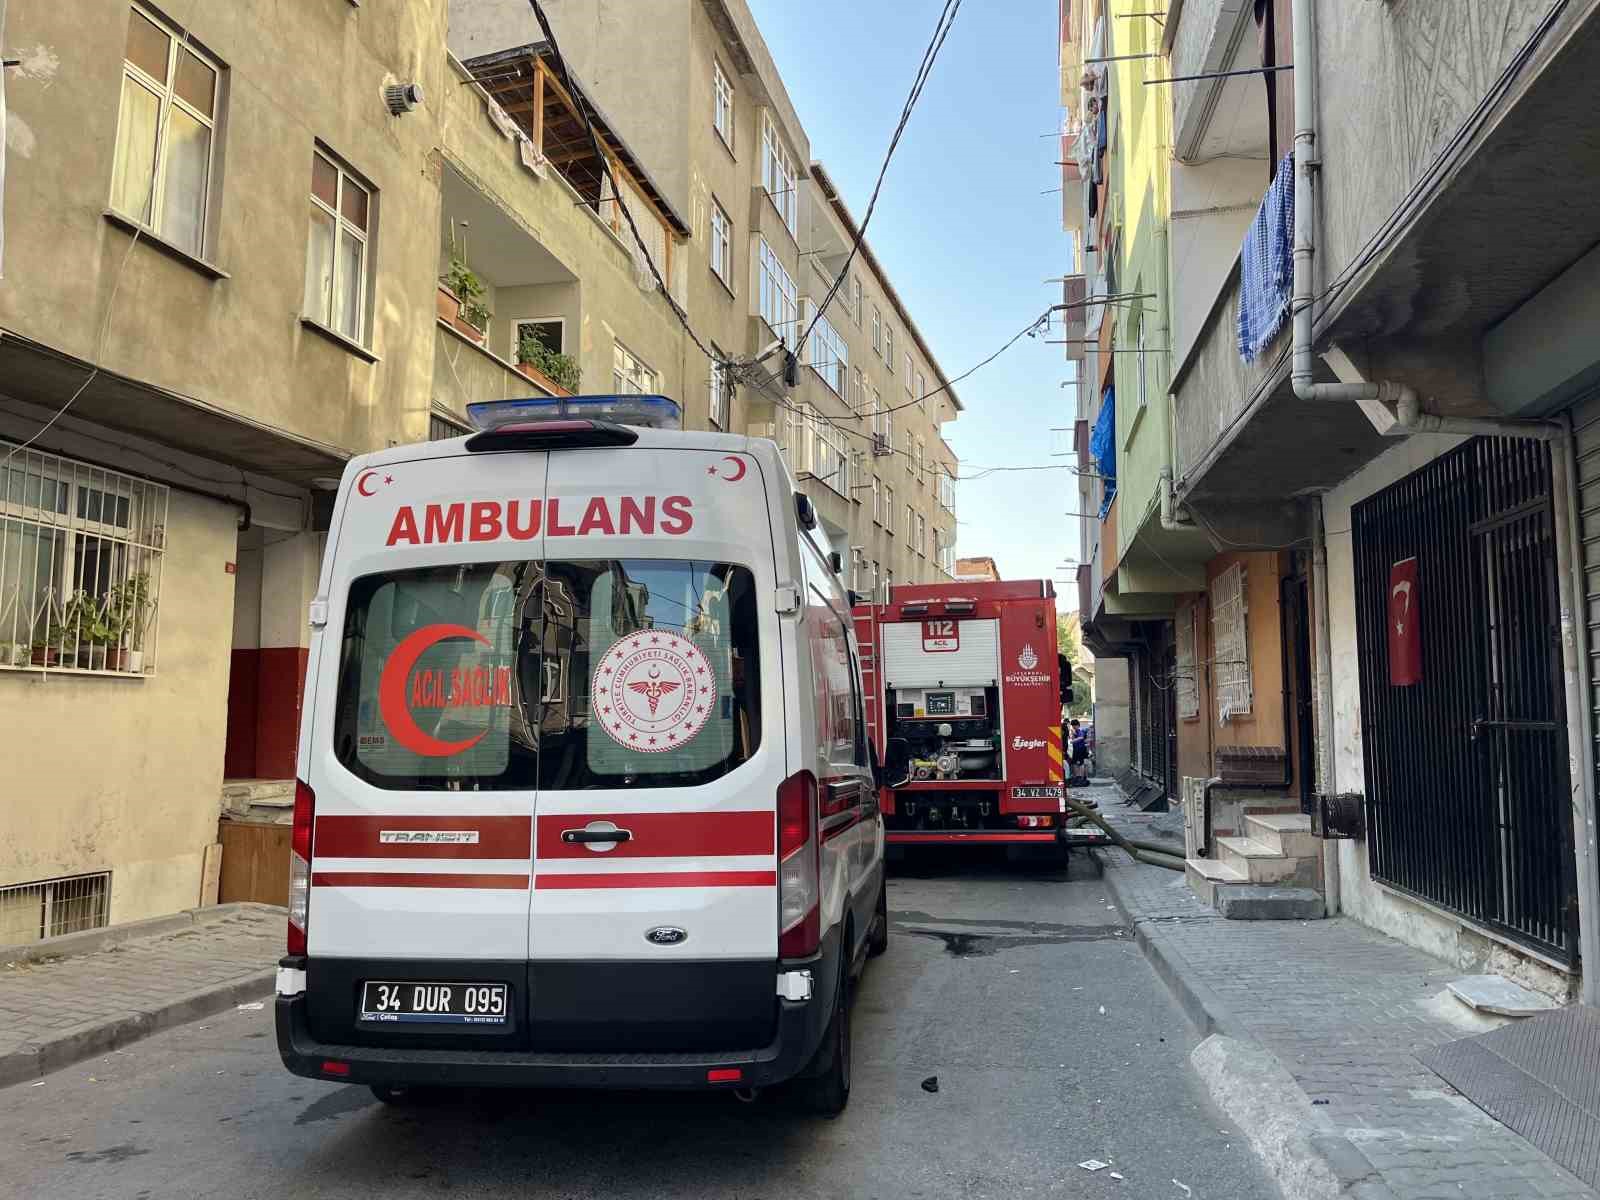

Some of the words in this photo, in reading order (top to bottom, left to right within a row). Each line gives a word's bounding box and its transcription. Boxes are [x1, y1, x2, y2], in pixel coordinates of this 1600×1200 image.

[385, 495, 695, 546] AMBULANS
[928, 621, 953, 636] 112
[1016, 788, 1026, 797] 34
[381, 831, 478, 843] TRANSIT
[376, 985, 401, 1011] 34
[412, 986, 452, 1012] DUR
[464, 987, 504, 1013] 095
